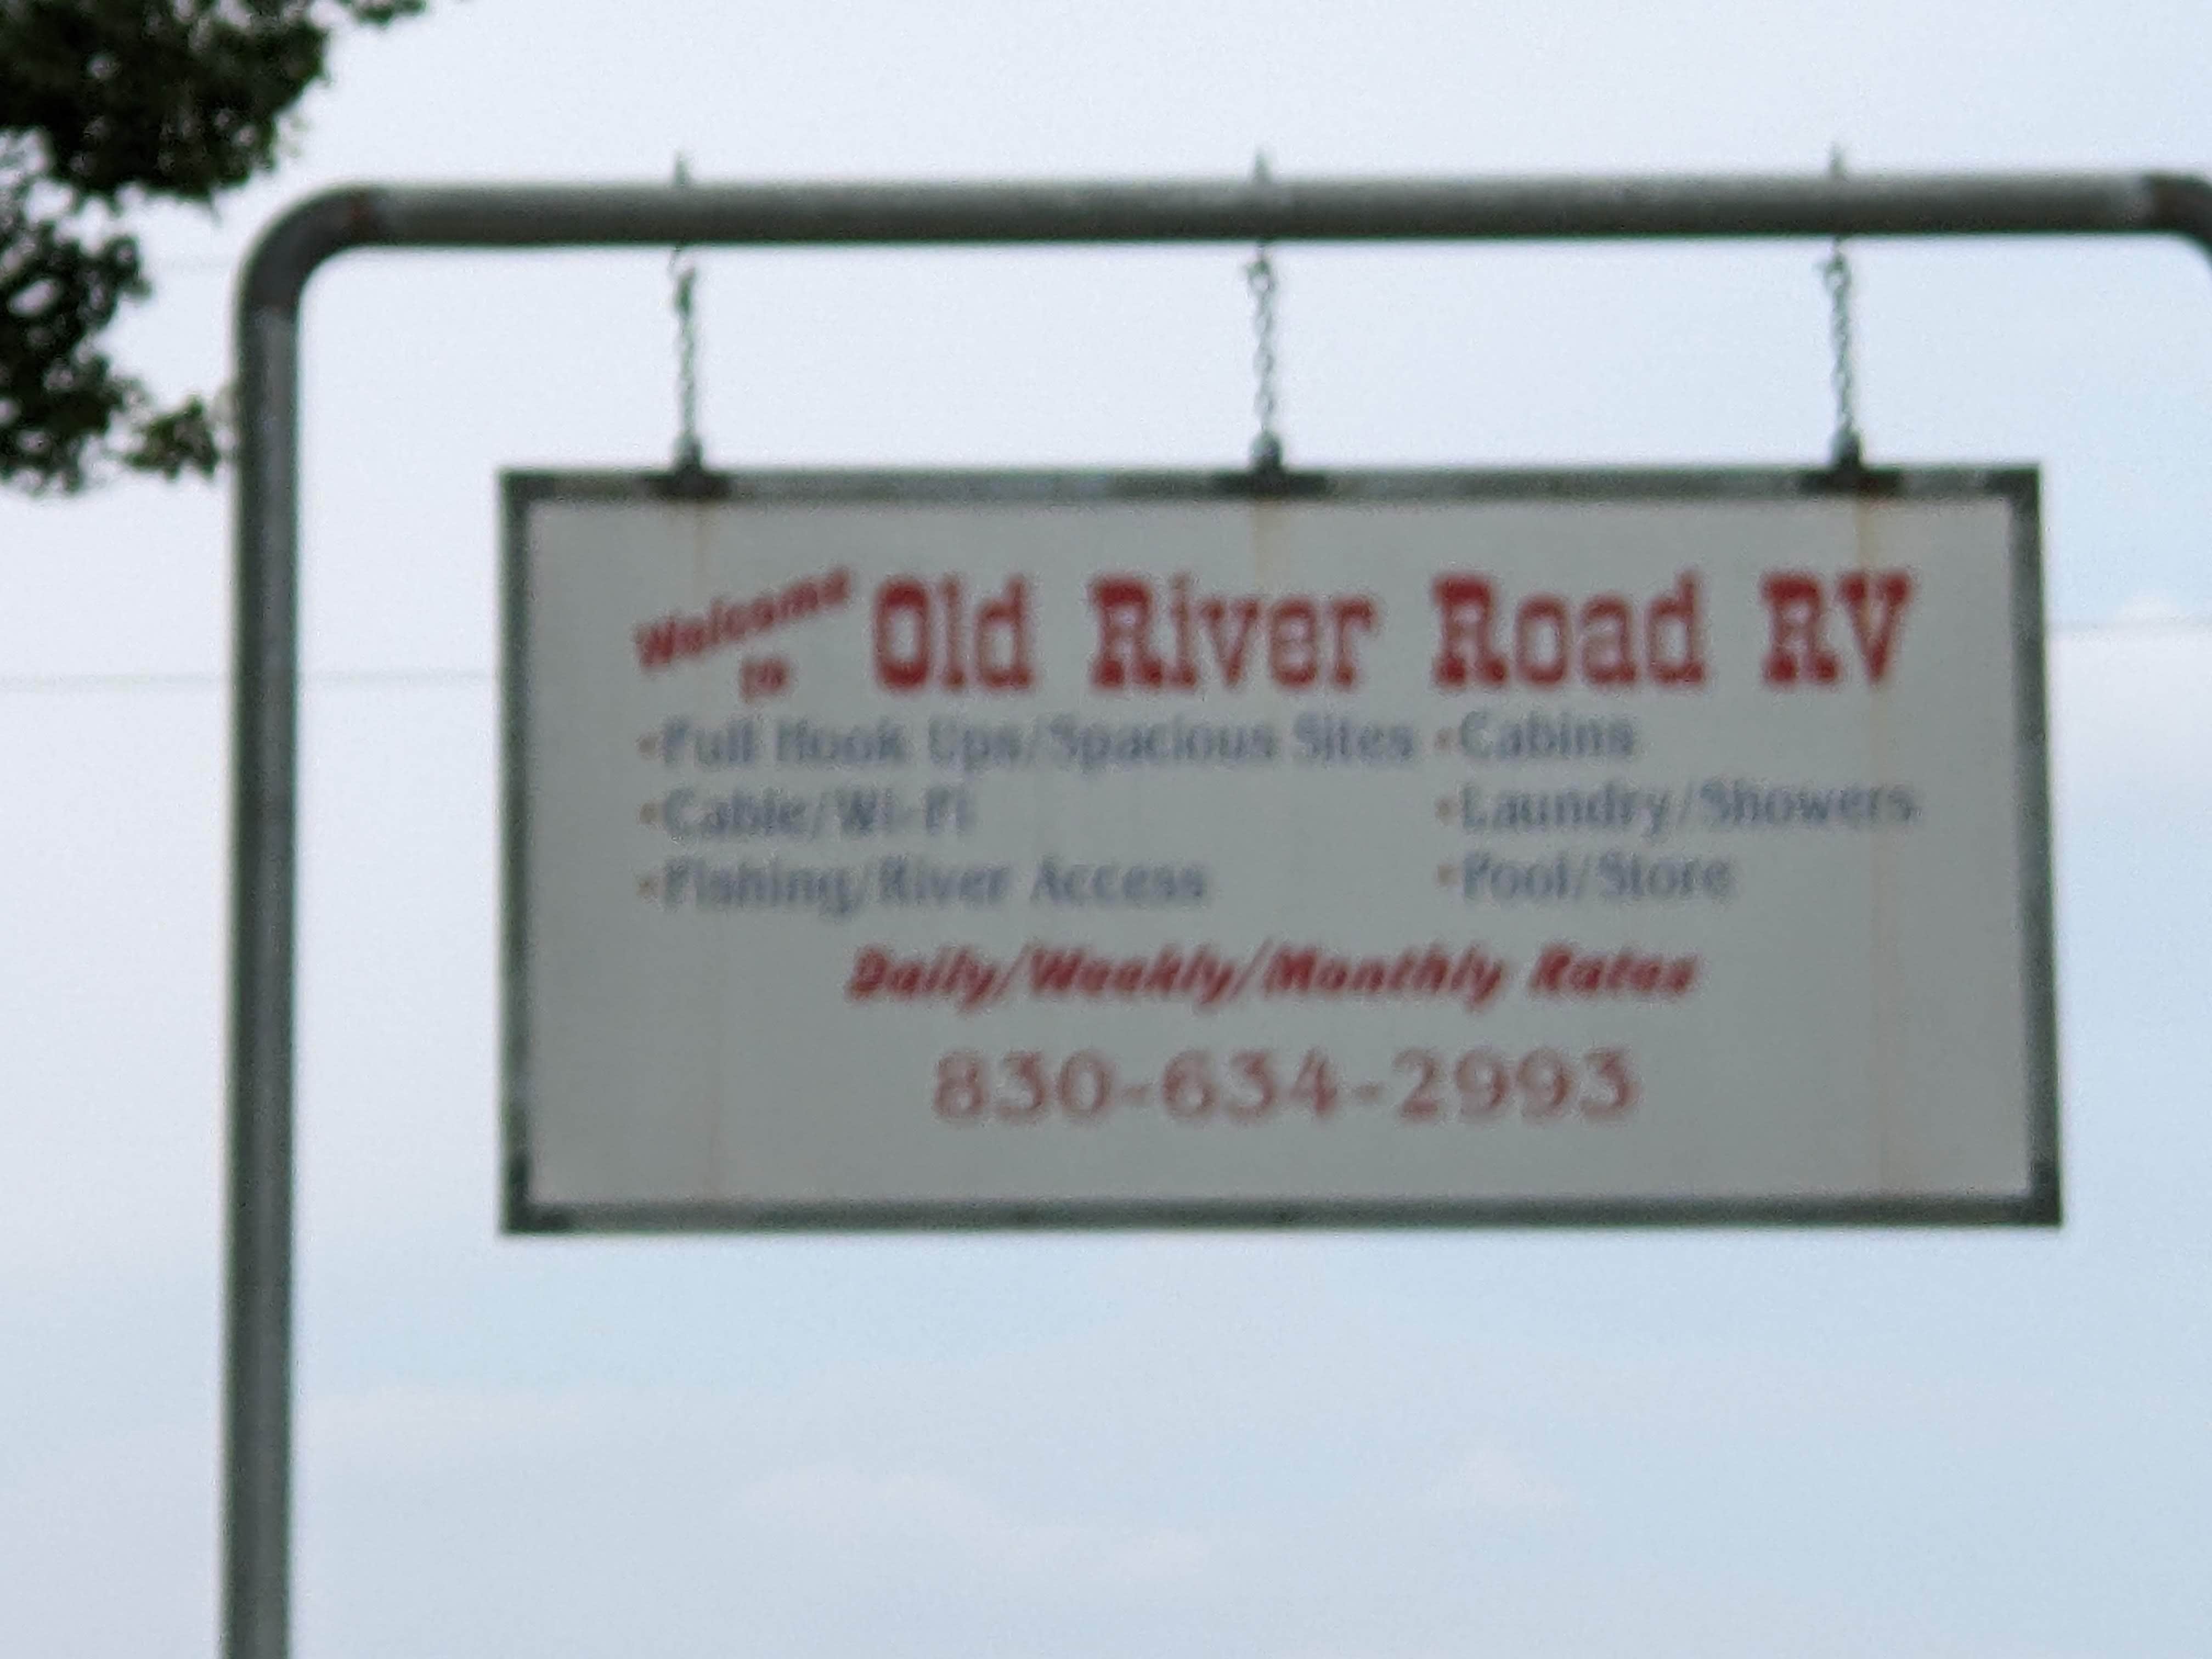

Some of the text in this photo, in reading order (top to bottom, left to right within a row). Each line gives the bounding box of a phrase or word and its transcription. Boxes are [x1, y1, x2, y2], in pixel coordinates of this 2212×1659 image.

[634, 565, 851, 674] Welcome
[873, 568, 1914, 692] Old River Road RV
[740, 658, 793, 702] to
[663, 712, 1415, 775] Full Hook Ups/Spacious Sites
[1460, 710, 1638, 761] Cabins
[664, 787, 974, 839] Cable/Wi-Fi
[1460, 779, 1917, 842] Laundry/Showers
[664, 857, 1210, 917] Fishing/River Access
[1460, 851, 1734, 902] Pool/Store
[848, 939, 1698, 1014] Daily/Weekly/Monthly Rates
[933, 1048, 1639, 1125] 830-634-2993
